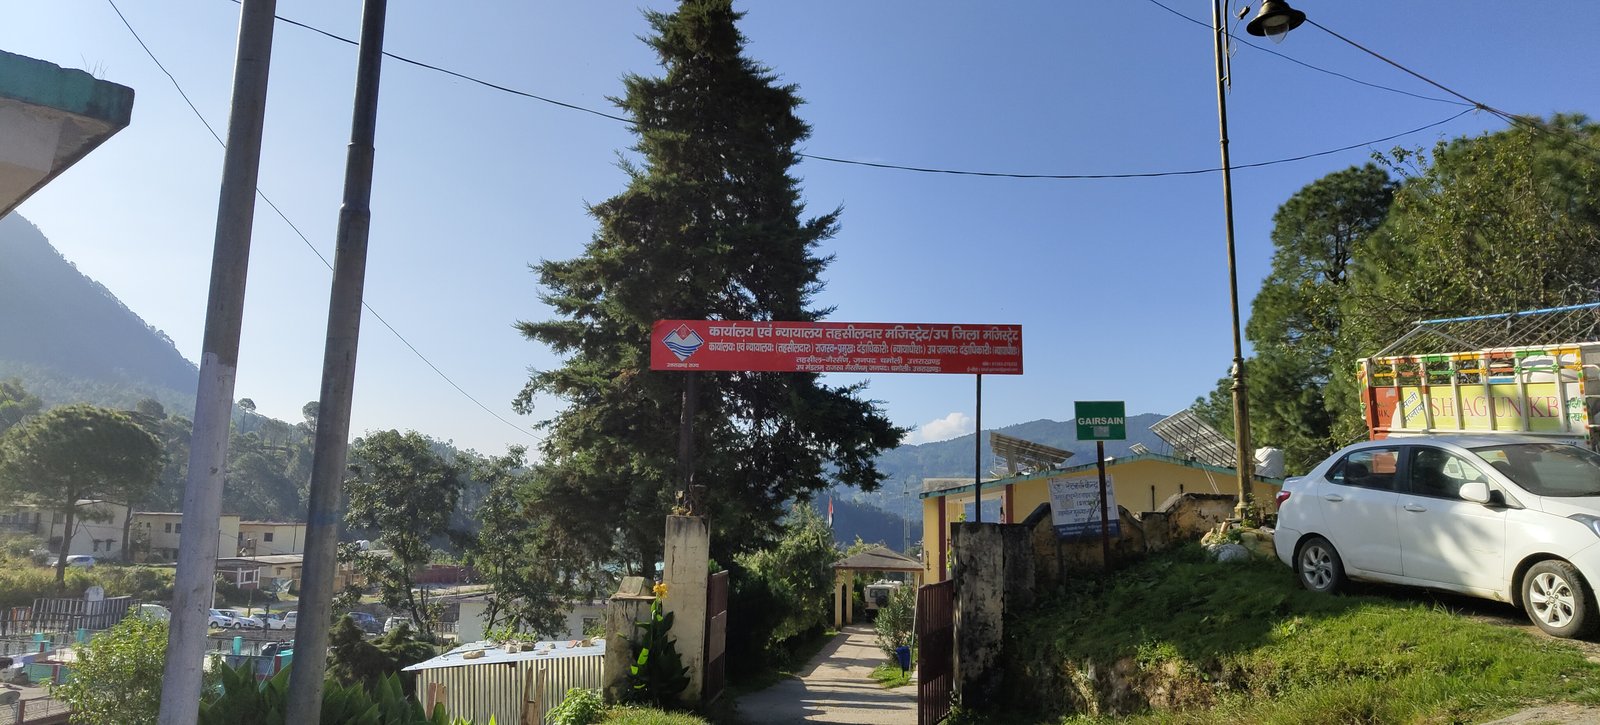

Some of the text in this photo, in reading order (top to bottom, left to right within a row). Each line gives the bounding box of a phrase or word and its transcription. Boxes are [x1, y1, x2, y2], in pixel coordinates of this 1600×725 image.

[709, 323, 754, 337] कार्यालय
[757, 324, 772, 337] एवं
[776, 327, 823, 339] न्यायालय
[825, 324, 882, 340] तहसीलदार
[952, 325, 980, 341] जिला
[1077, 417, 1124, 425] GAIRSAIN
